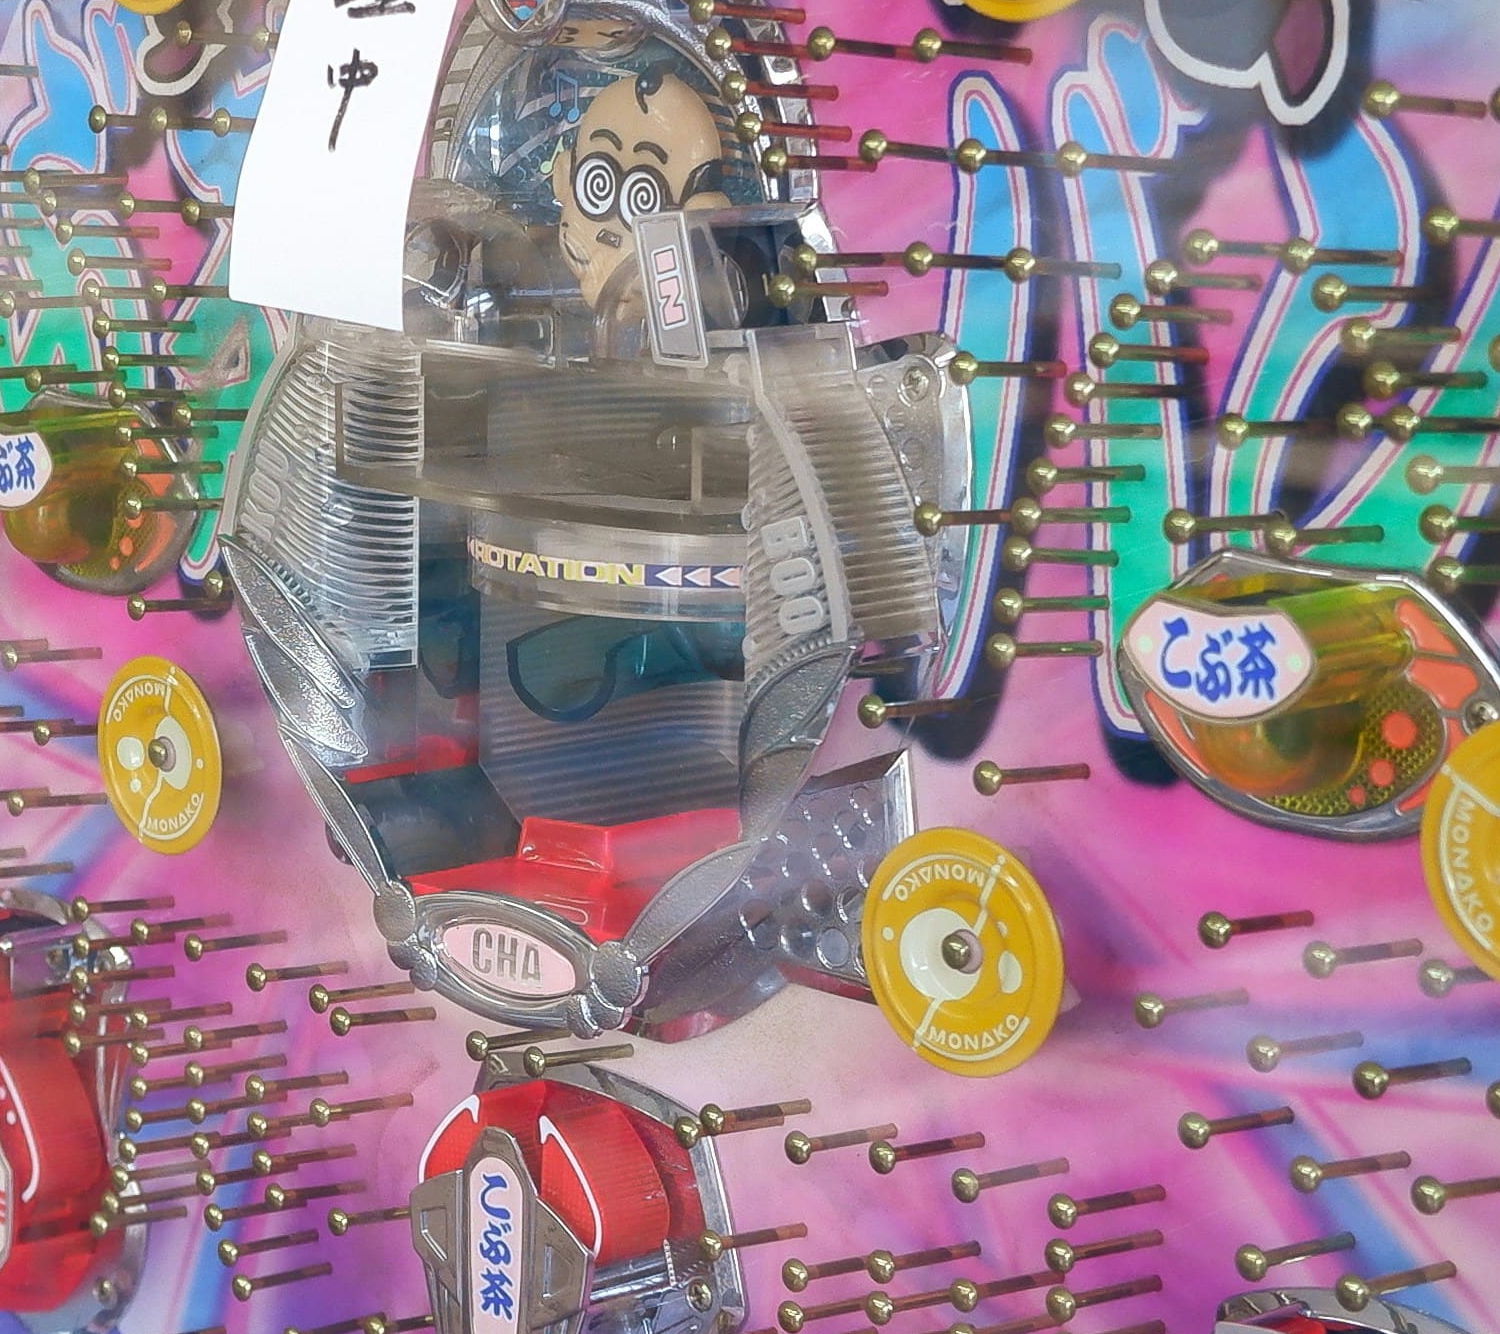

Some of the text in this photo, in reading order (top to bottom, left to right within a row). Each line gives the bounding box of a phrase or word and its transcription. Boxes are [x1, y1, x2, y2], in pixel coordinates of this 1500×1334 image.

[651, 244, 690, 331] IN
[474, 537, 646, 587] ROTATION
[1160, 616, 1277, 703] こぶ茶
[112, 681, 166, 723] MONAKO
[147, 792, 201, 832] MONAKO
[894, 863, 986, 901] MONAKO
[1451, 798, 1495, 933] MONAKO
[471, 926, 542, 987] CHA
[927, 1013, 1021, 1050] MONAKO
[479, 1171, 517, 1323] こぶ茶
